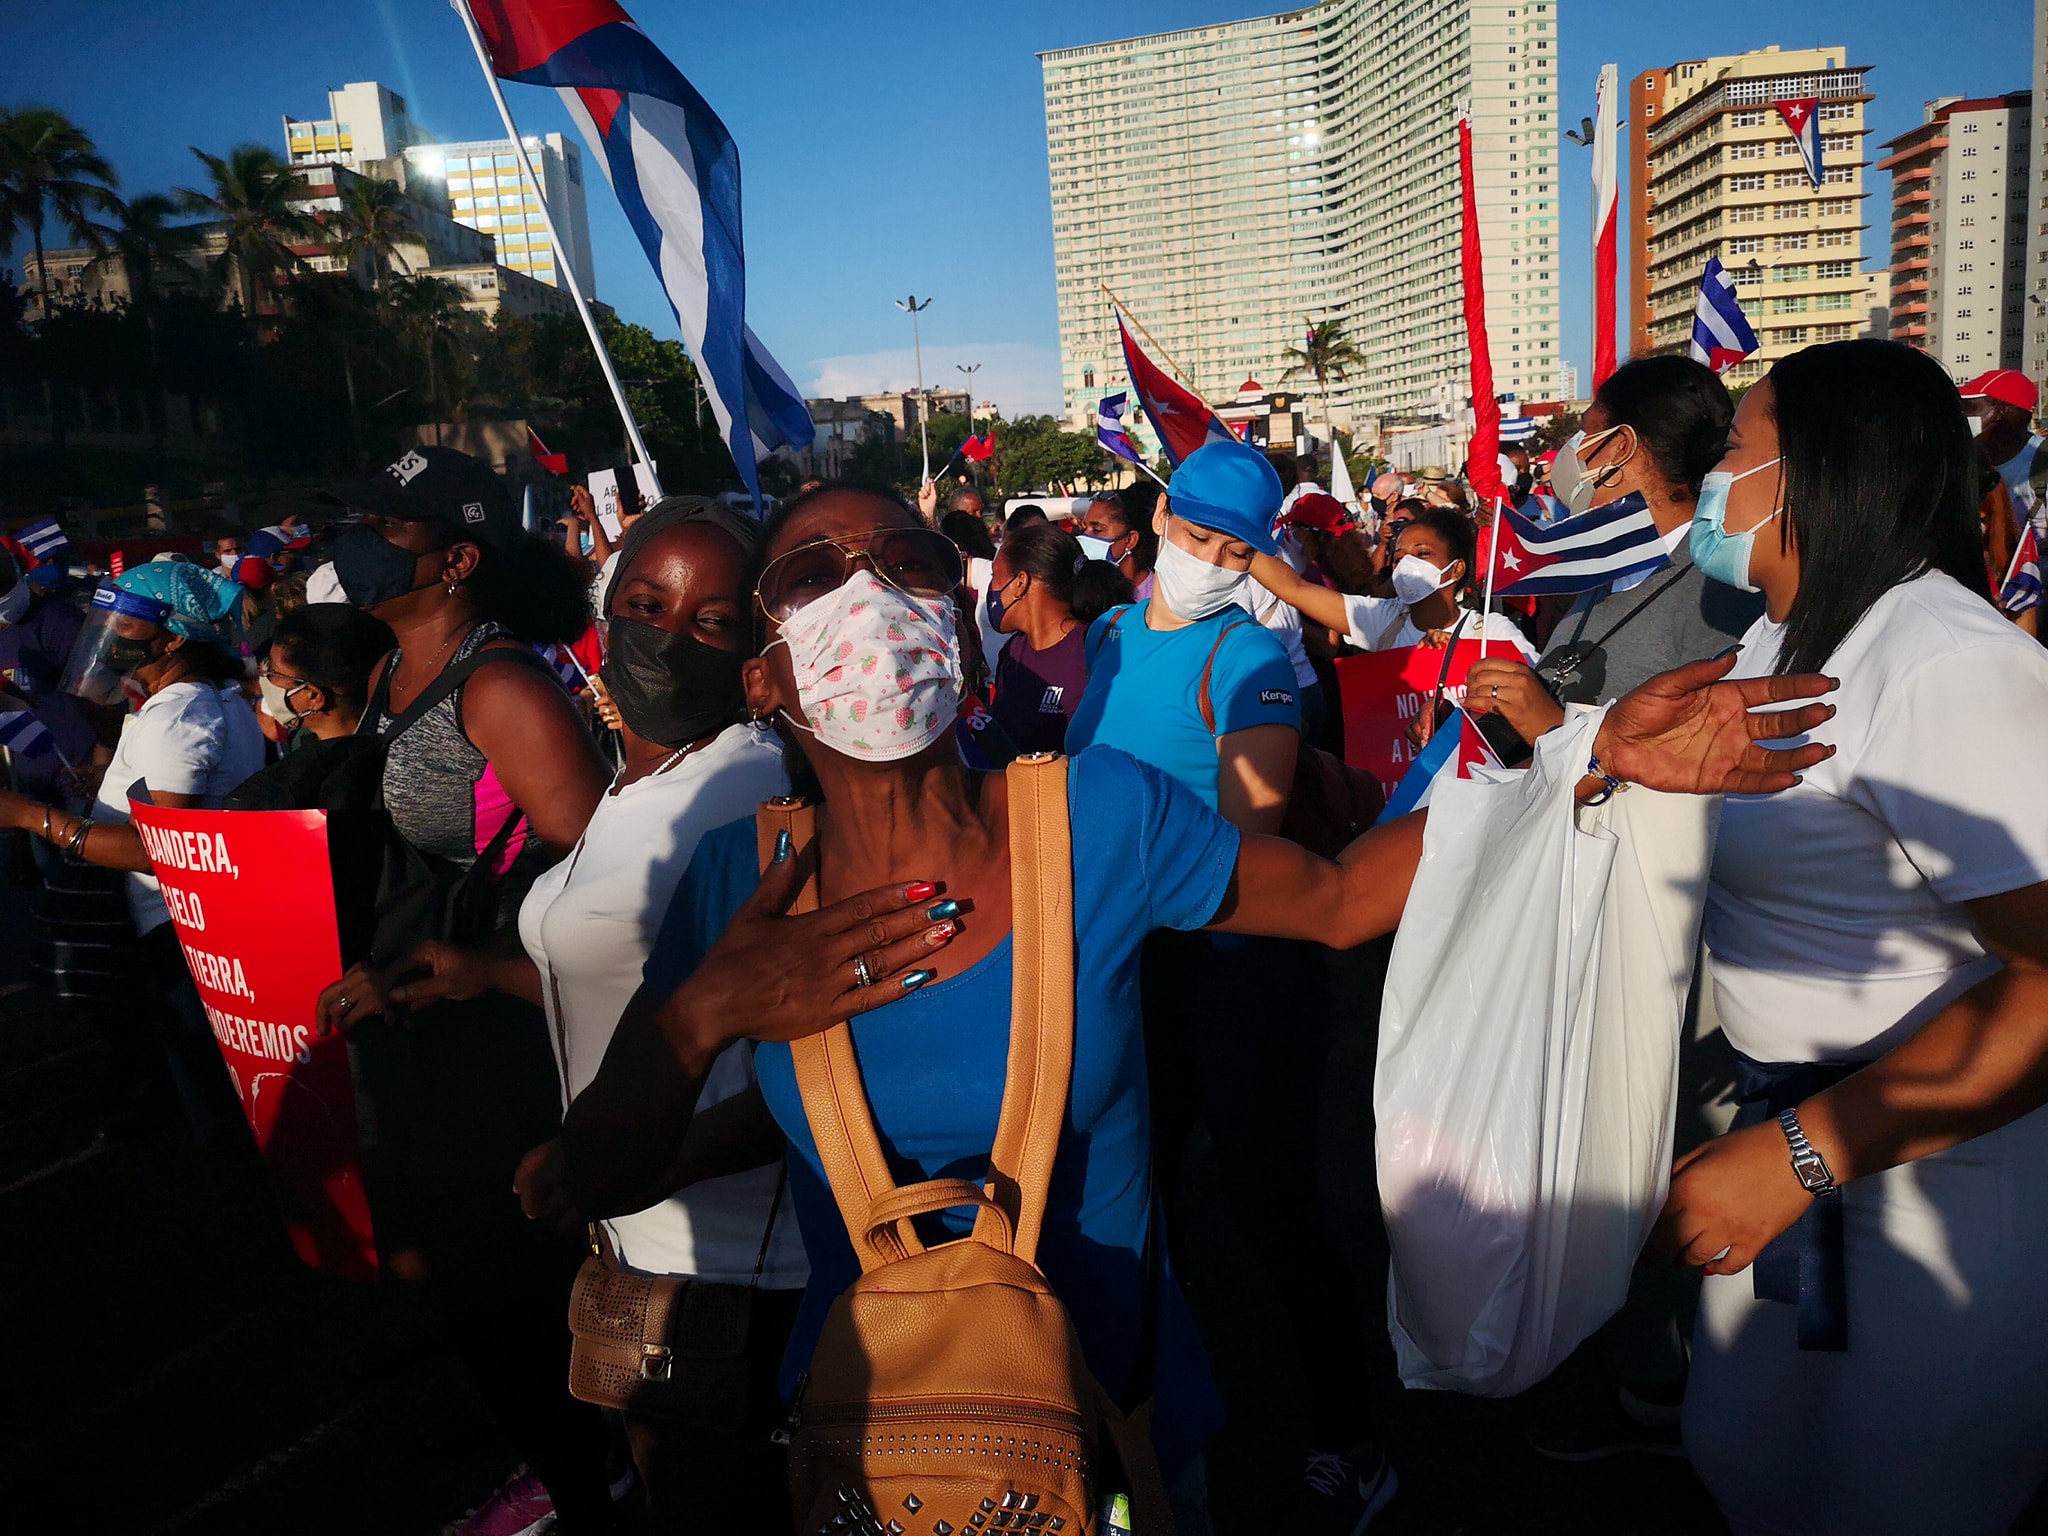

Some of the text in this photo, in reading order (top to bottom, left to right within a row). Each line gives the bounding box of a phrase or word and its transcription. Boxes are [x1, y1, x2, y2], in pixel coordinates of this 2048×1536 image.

[1396, 692, 1420, 719] NO
[1392, 738, 1403, 764] A
[142, 822, 239, 880] BANDERA,
[161, 882, 206, 932] CIELO
[185, 944, 255, 1004] TIERRA,
[200, 998, 312, 1065] NDEREMOS
